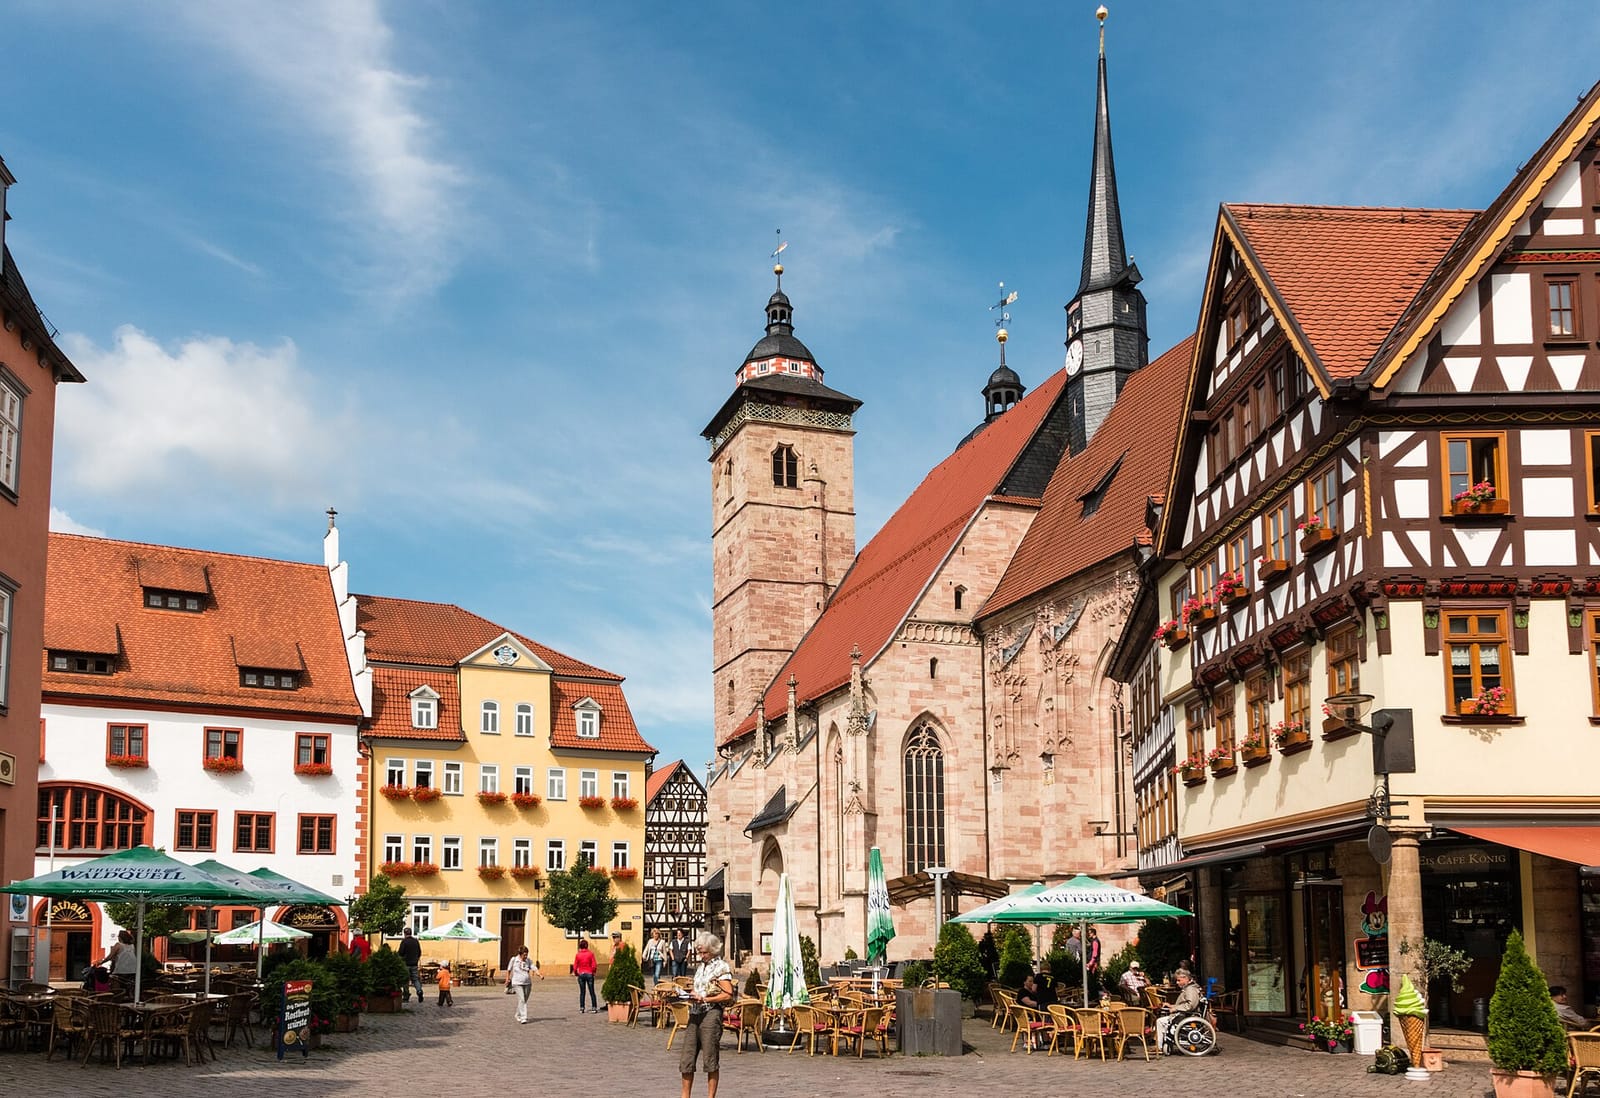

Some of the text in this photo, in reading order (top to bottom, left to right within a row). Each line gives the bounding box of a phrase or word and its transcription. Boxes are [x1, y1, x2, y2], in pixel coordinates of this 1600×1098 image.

[61, 870, 186, 880] WALDQUELL
[1037, 895, 1142, 904] WALDQUELL
[1046, 977, 1051, 988] 7
